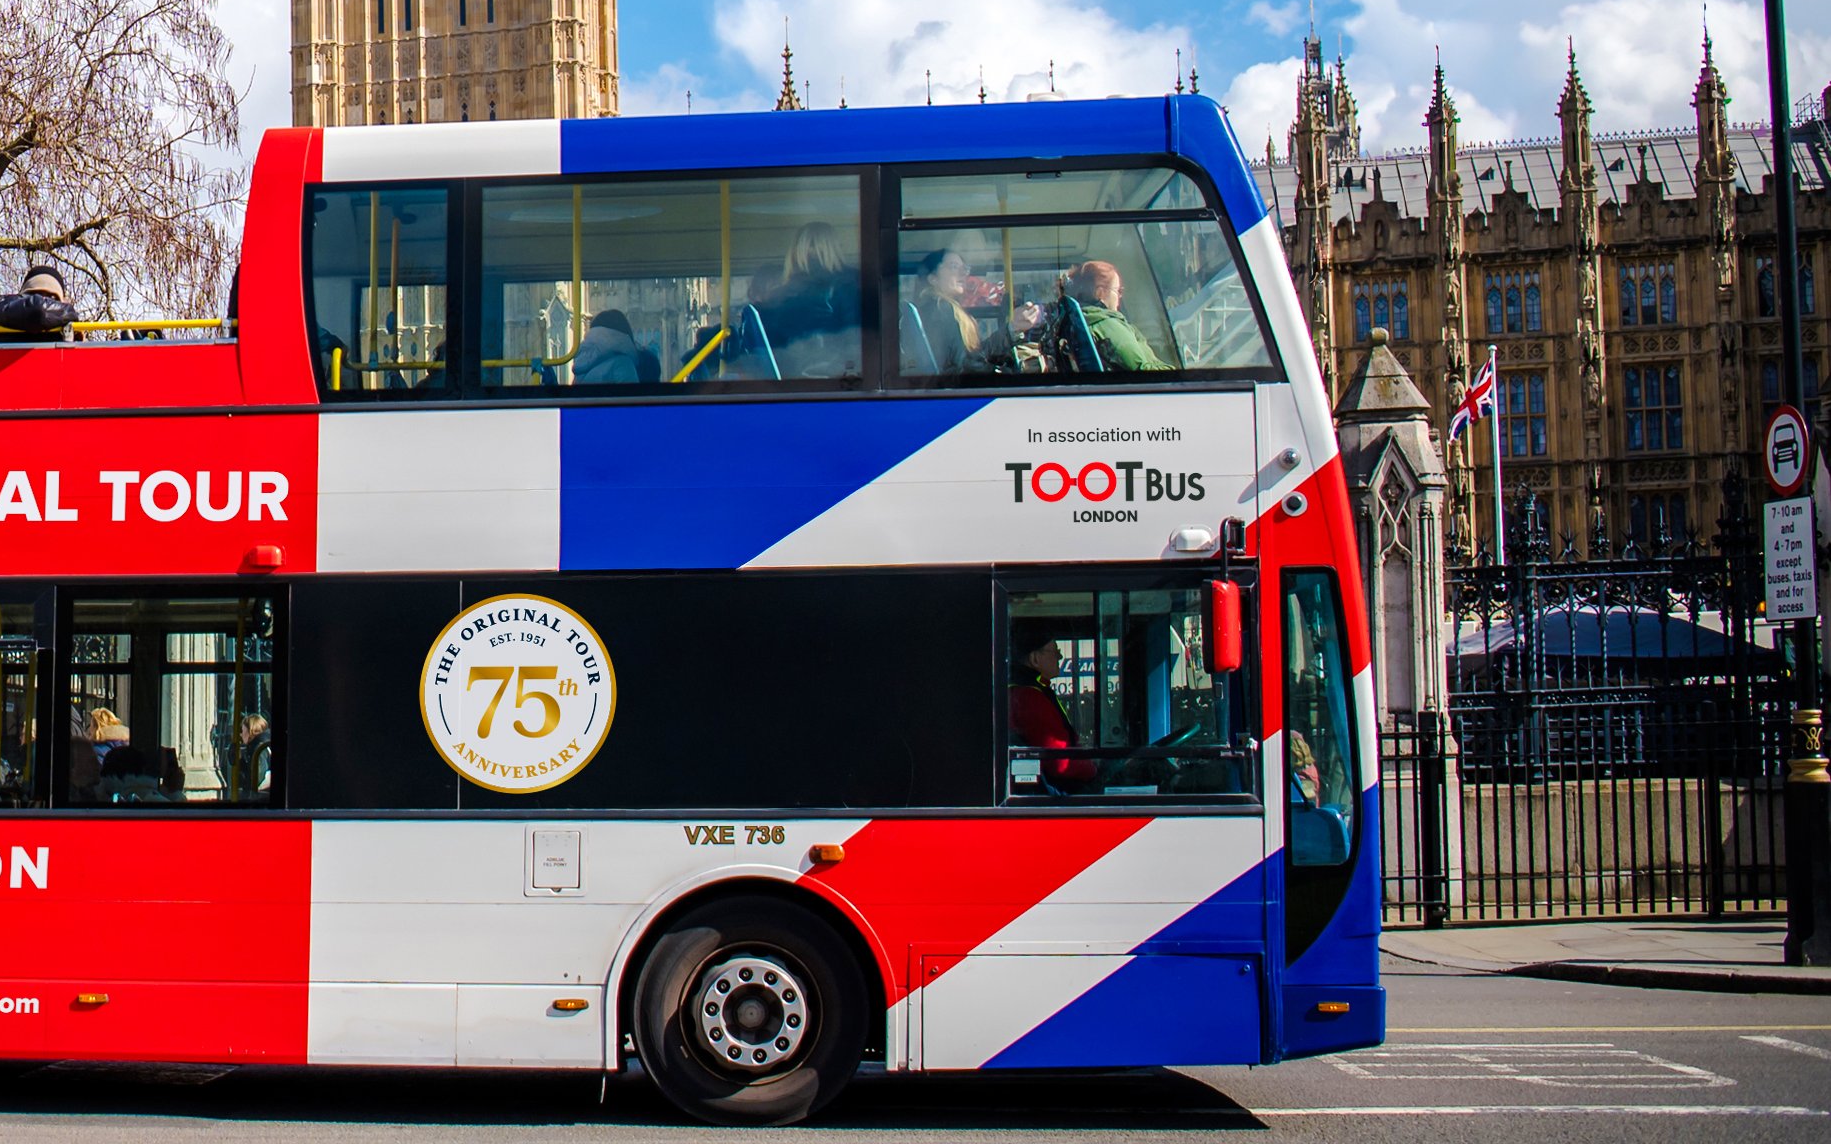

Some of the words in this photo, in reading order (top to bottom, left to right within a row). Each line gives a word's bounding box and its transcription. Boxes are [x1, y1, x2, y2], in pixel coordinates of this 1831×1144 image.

[1028, 429, 1042, 443] In
[1048, 427, 1141, 443] association
[1146, 427, 1181, 441] with
[99, 470, 290, 523] TOUR
[1073, 510, 1138, 523] LONDON
[1781, 522, 1795, 534] and
[1776, 555, 1802, 568] except
[1793, 570, 1812, 581] taxis
[1776, 589, 1790, 598] and
[1792, 586, 1804, 596] for
[1778, 603, 1804, 613] access
[490, 633, 515, 647] EST.
[520, 632, 546, 647] 1951
[435, 644, 461, 685] THE
[461, 609, 562, 641] ORIGINAL
[567, 630, 601, 686] TOUR
[467, 666, 561, 738] 75
[558, 679, 578, 696] th
[452, 738, 581, 778] ANNIVERSARY
[683, 826, 734, 844] VXE
[744, 826, 785, 844] 736
